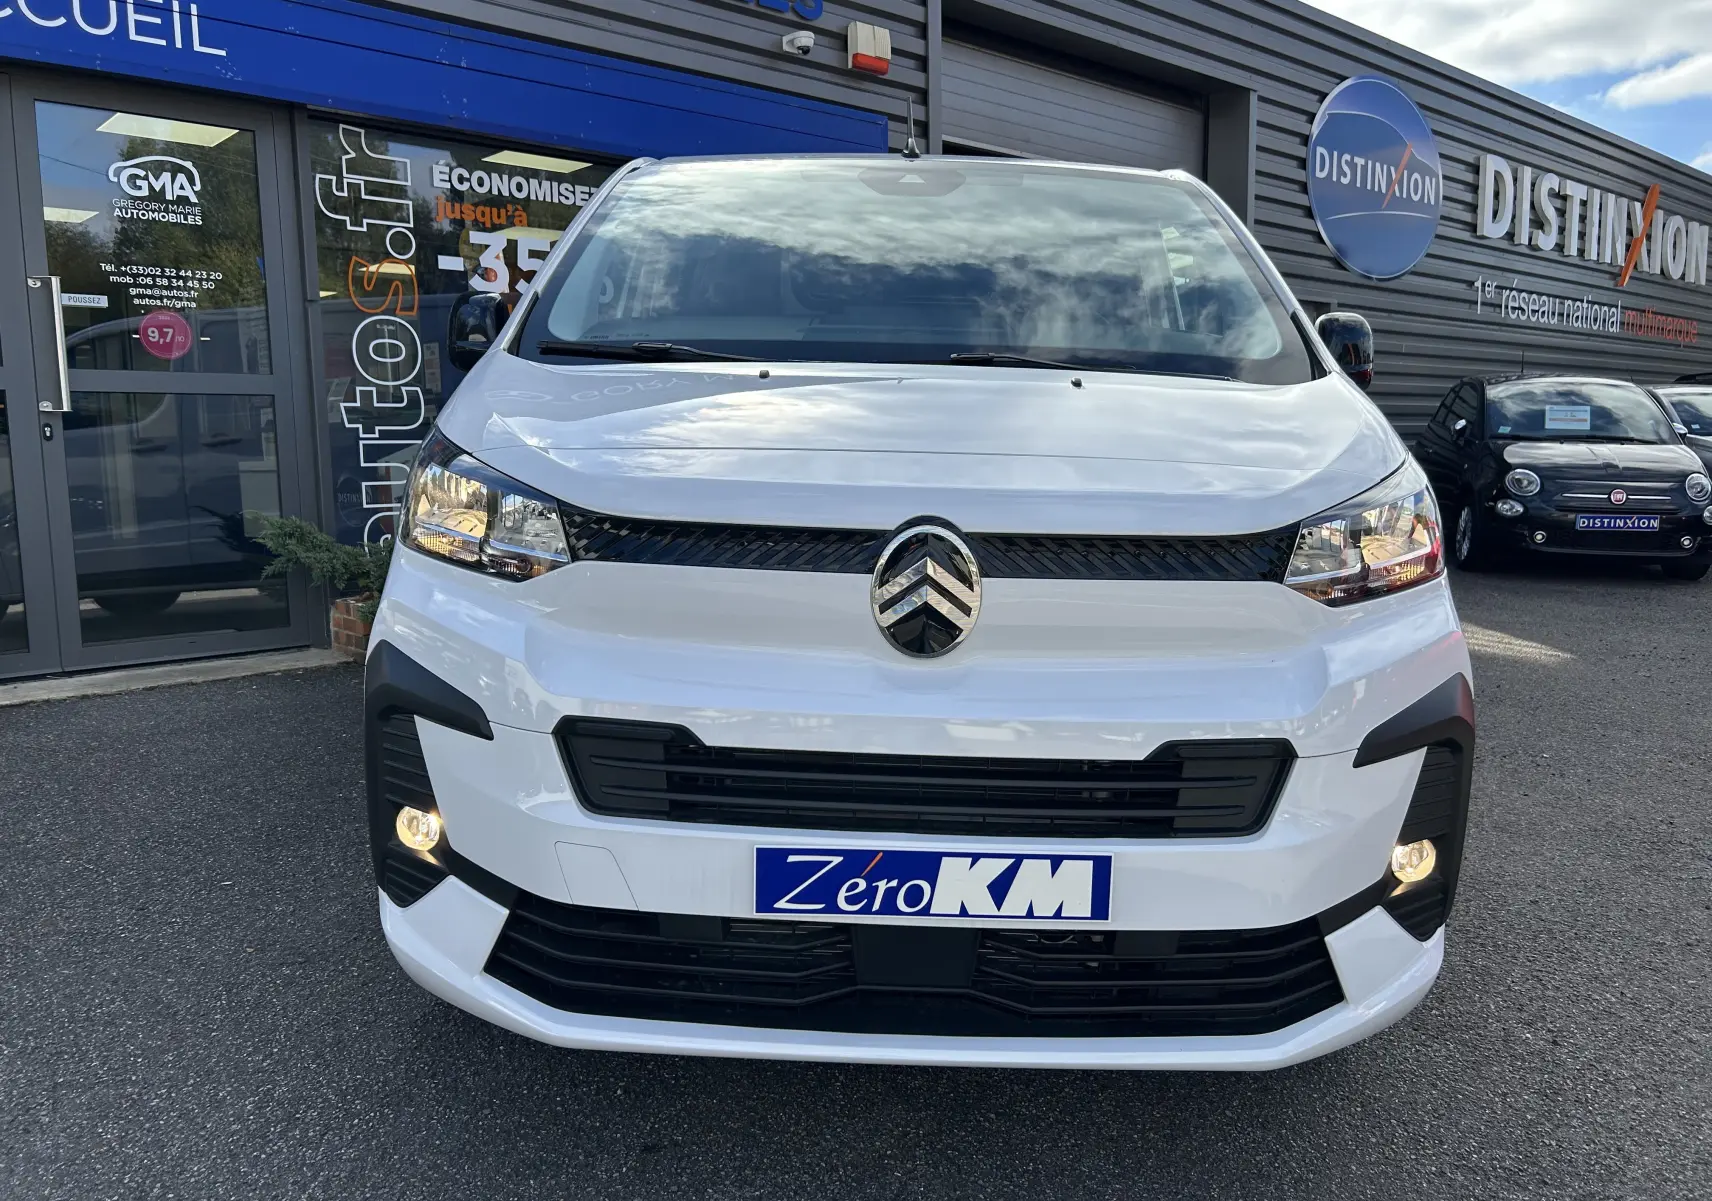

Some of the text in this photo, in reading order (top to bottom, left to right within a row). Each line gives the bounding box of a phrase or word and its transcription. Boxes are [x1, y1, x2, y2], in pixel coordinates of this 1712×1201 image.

[120, 167, 199, 203] GMA
[1315, 143, 1436, 209] DISTINXION
[112, 198, 202, 216] GREGORY MARIE
[435, 196, 528, 228] jusqu'à
[113, 208, 203, 226] AUTOMOBILES
[1476, 153, 1710, 287] DISTINXION
[100, 263, 223, 280] Tél. +(33)02 32 44 23 20
[109, 275, 134, 284] mob
[156, 278, 169, 286] 58
[171, 279, 184, 287] 34
[187, 280, 200, 289] 45
[201, 281, 215, 290] 50
[67, 295, 102, 304] POUSSEZ
[129, 287, 199, 298] gma@autos.fr
[133, 298, 197, 308] autos.fr/gma
[1501, 278, 1559, 325] réseau
[1563, 295, 1621, 333] national
[1624, 305, 1698, 349] multimarque
[147, 326, 174, 345] 9,7
[1579, 516, 1658, 530] DISTINXION
